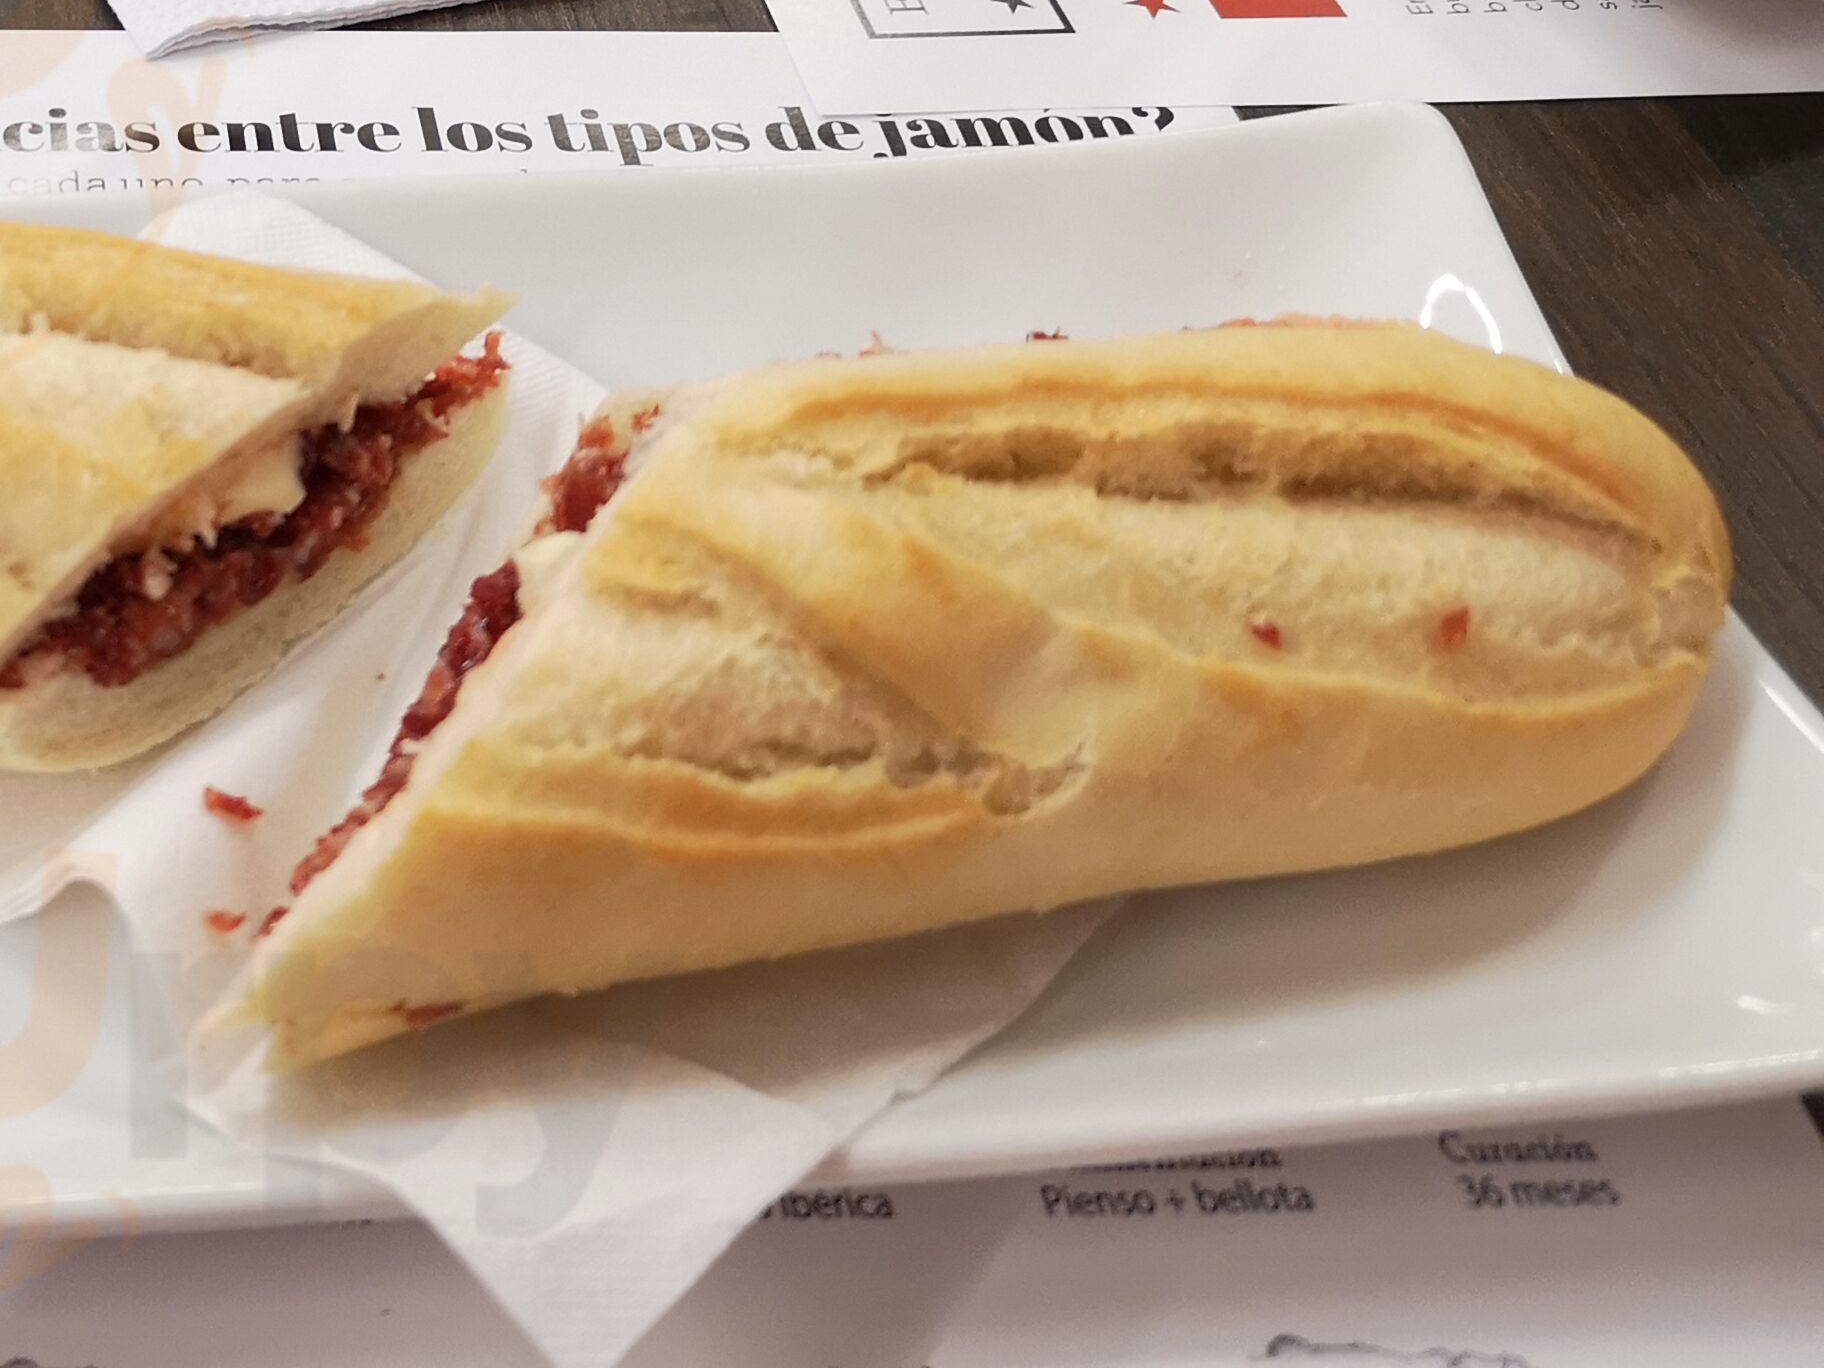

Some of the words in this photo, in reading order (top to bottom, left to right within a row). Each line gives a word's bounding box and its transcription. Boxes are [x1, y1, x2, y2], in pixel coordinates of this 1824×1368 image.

[177, 112, 403, 154] entre
[411, 106, 534, 154] los
[546, 108, 752, 167] tipos
[764, 106, 865, 153] de
[1039, 1183, 1156, 1220] Pienso
[1191, 1178, 1316, 1215] bellota
